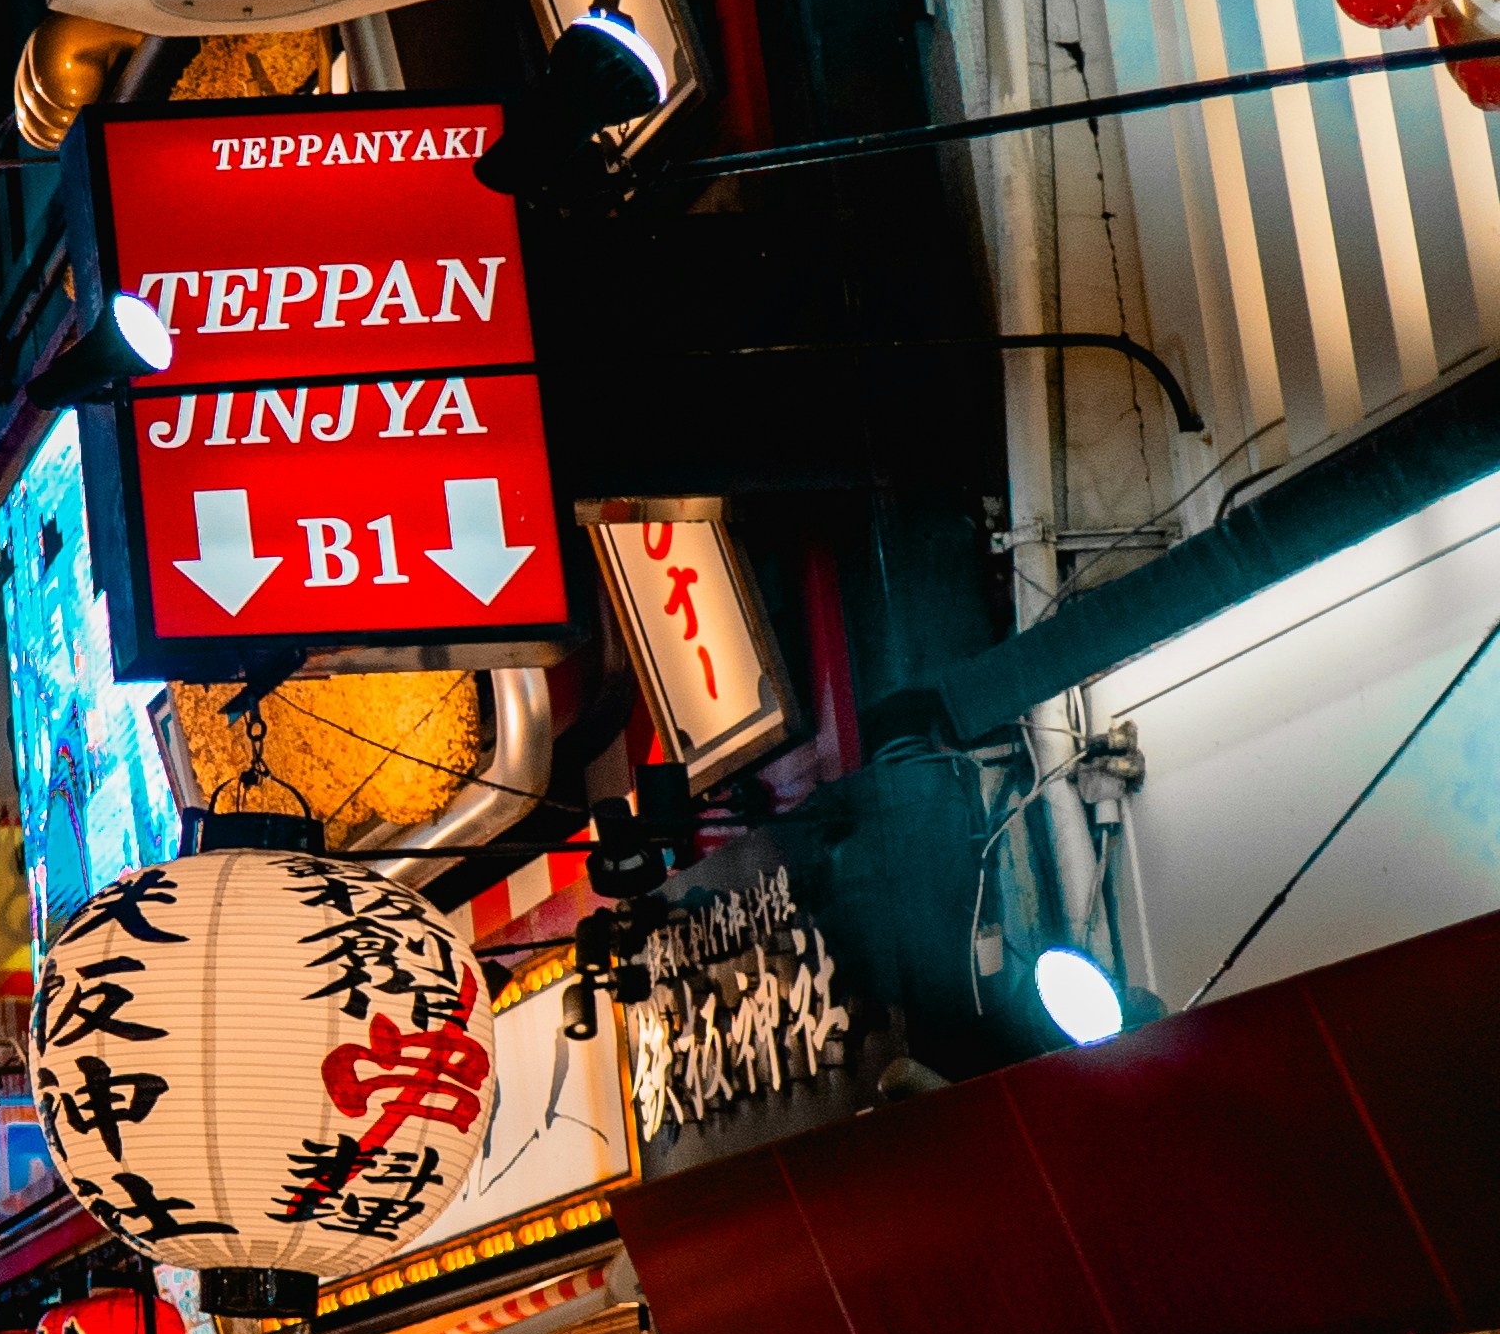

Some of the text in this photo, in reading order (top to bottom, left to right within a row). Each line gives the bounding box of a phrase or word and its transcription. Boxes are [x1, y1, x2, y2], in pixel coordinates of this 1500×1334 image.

[211, 127, 487, 171] TEPPANYAKI
[138, 257, 506, 336] TEPPAN
[148, 376, 488, 450] JINJYA
[297, 513, 410, 588] B1
